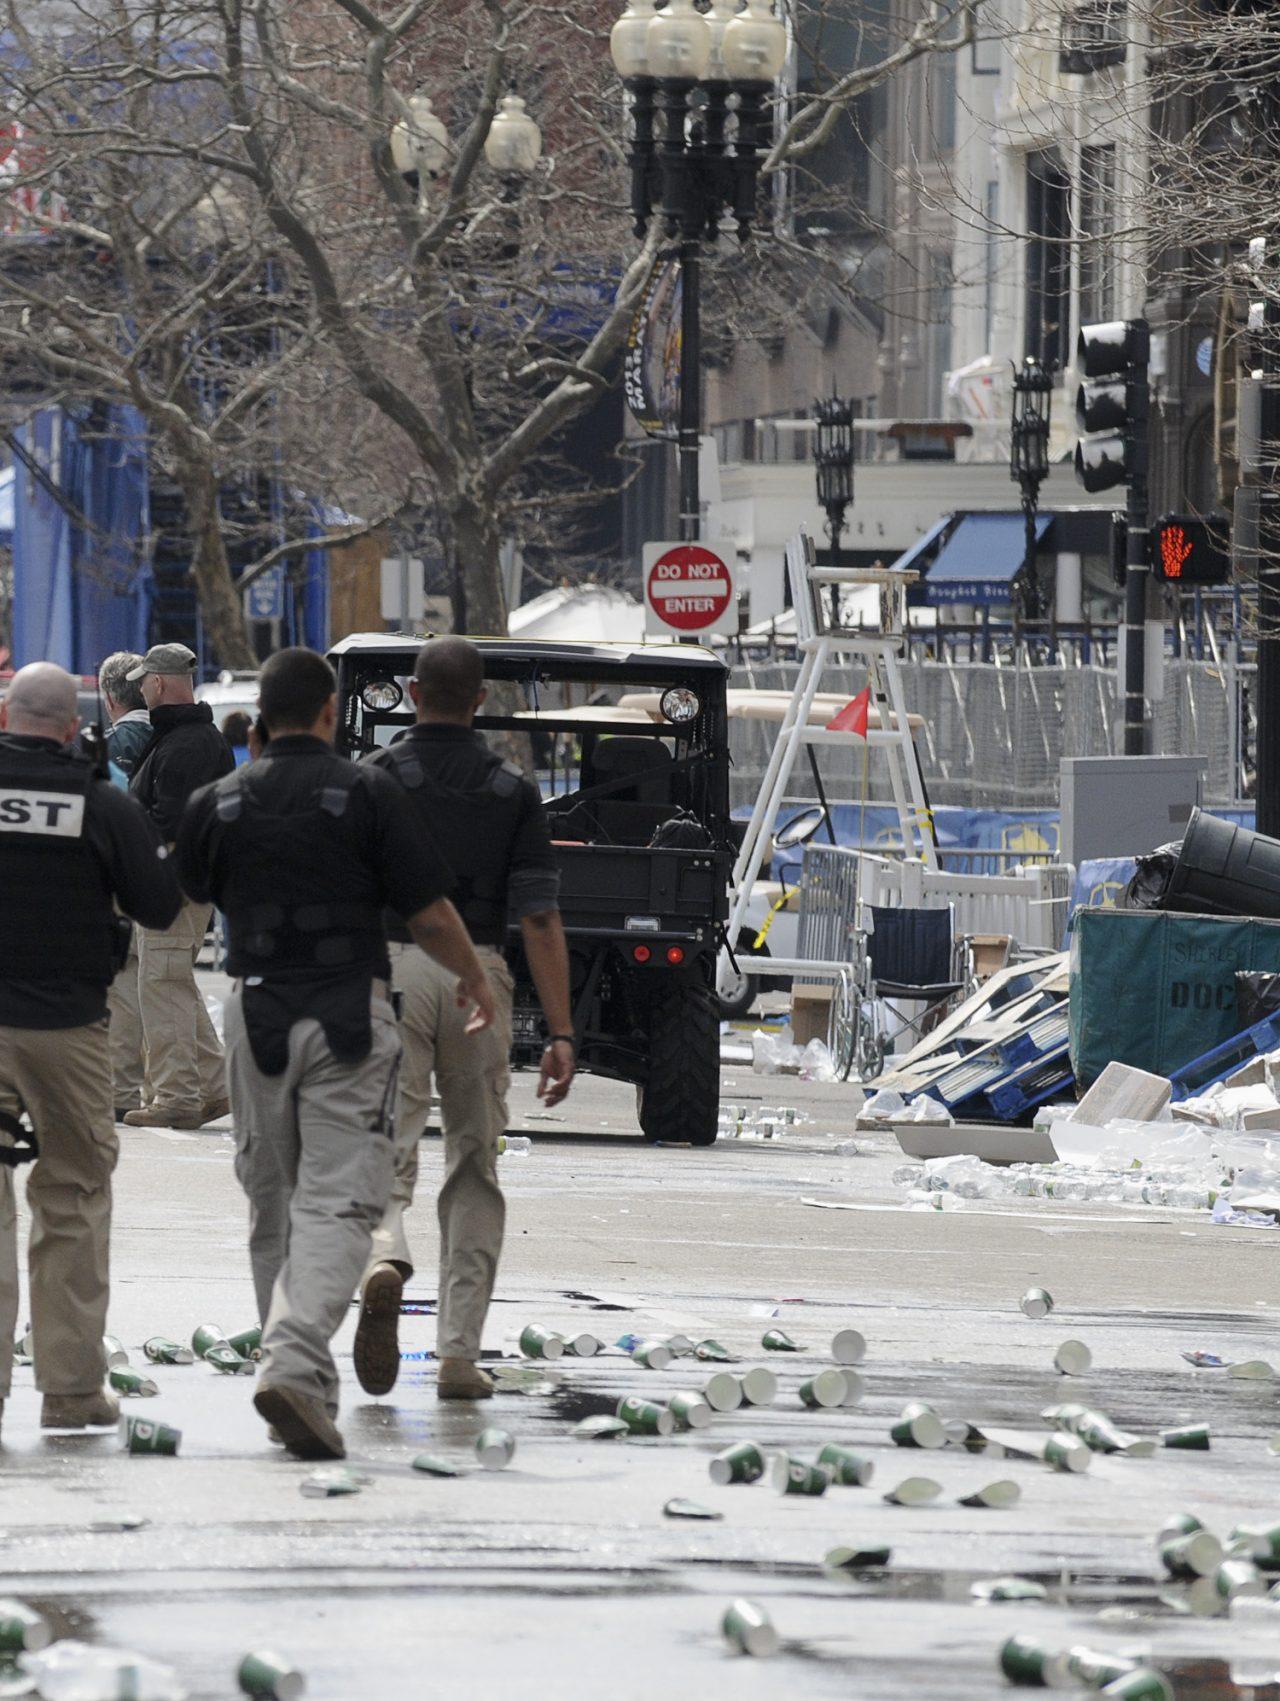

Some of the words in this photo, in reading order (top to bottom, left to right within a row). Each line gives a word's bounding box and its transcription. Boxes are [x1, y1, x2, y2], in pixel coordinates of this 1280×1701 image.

[625, 355, 638, 409] 2013
[658, 564, 681, 579] DO
[687, 563, 720, 578] NOT
[665, 598, 715, 613] ENTER
